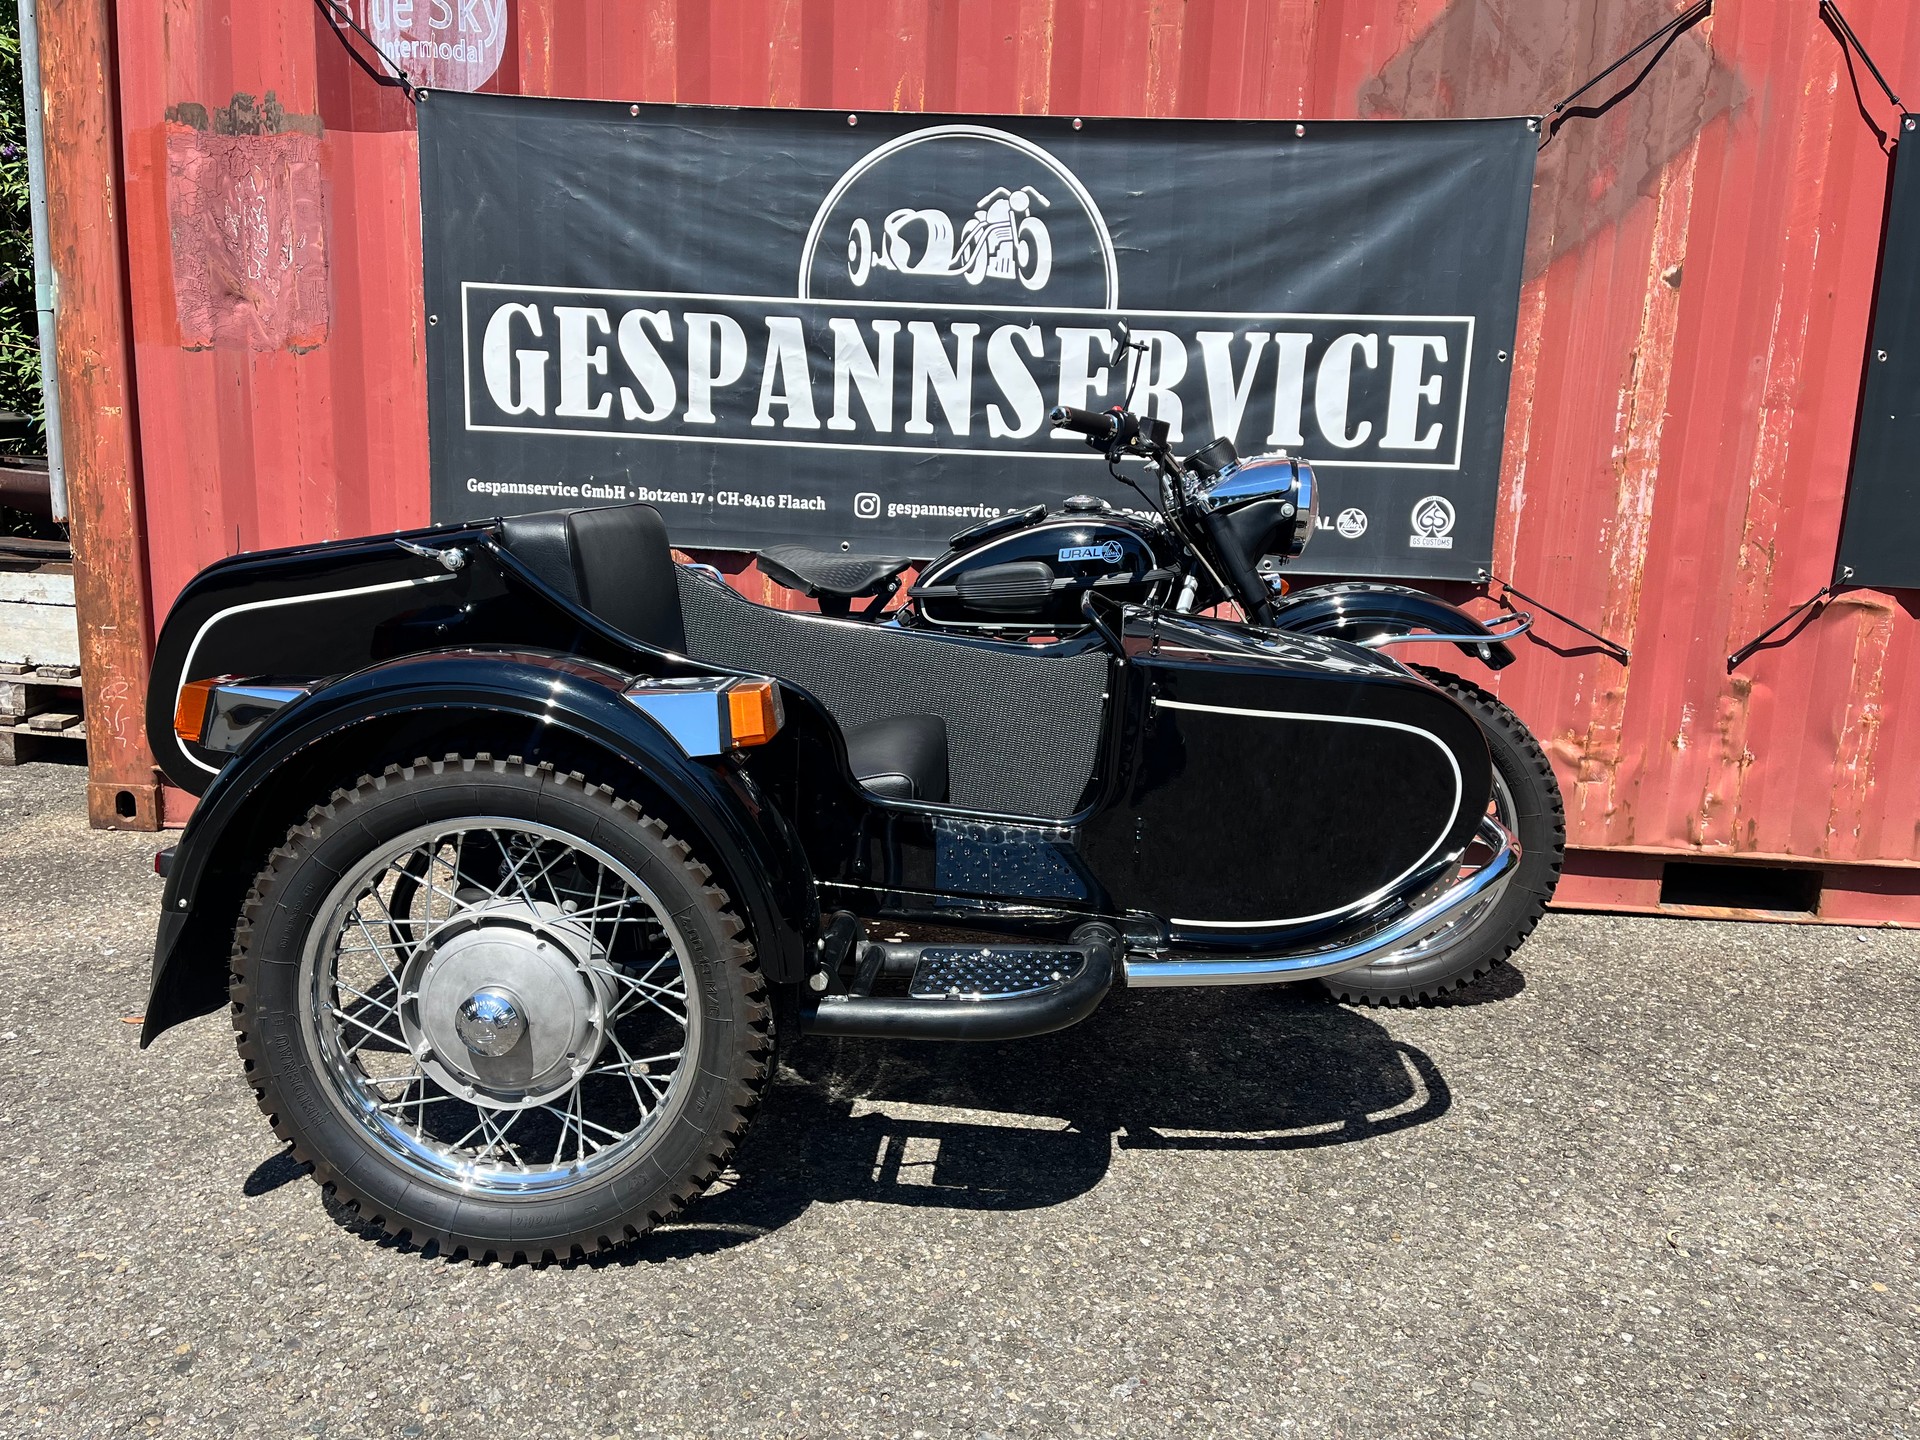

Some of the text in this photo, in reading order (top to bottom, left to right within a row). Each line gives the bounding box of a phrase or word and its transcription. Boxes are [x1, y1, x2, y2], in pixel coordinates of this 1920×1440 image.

[381, 38, 484, 62] Intermodal
[482, 303, 1449, 449] GESPANNSERVICE
[466, 478, 827, 511] Gespannservice GmbH Botzen 17 CH-8416 Flaach
[1061, 547, 1101, 560] URAL
[1422, 538, 1451, 547] CUSTOMS
